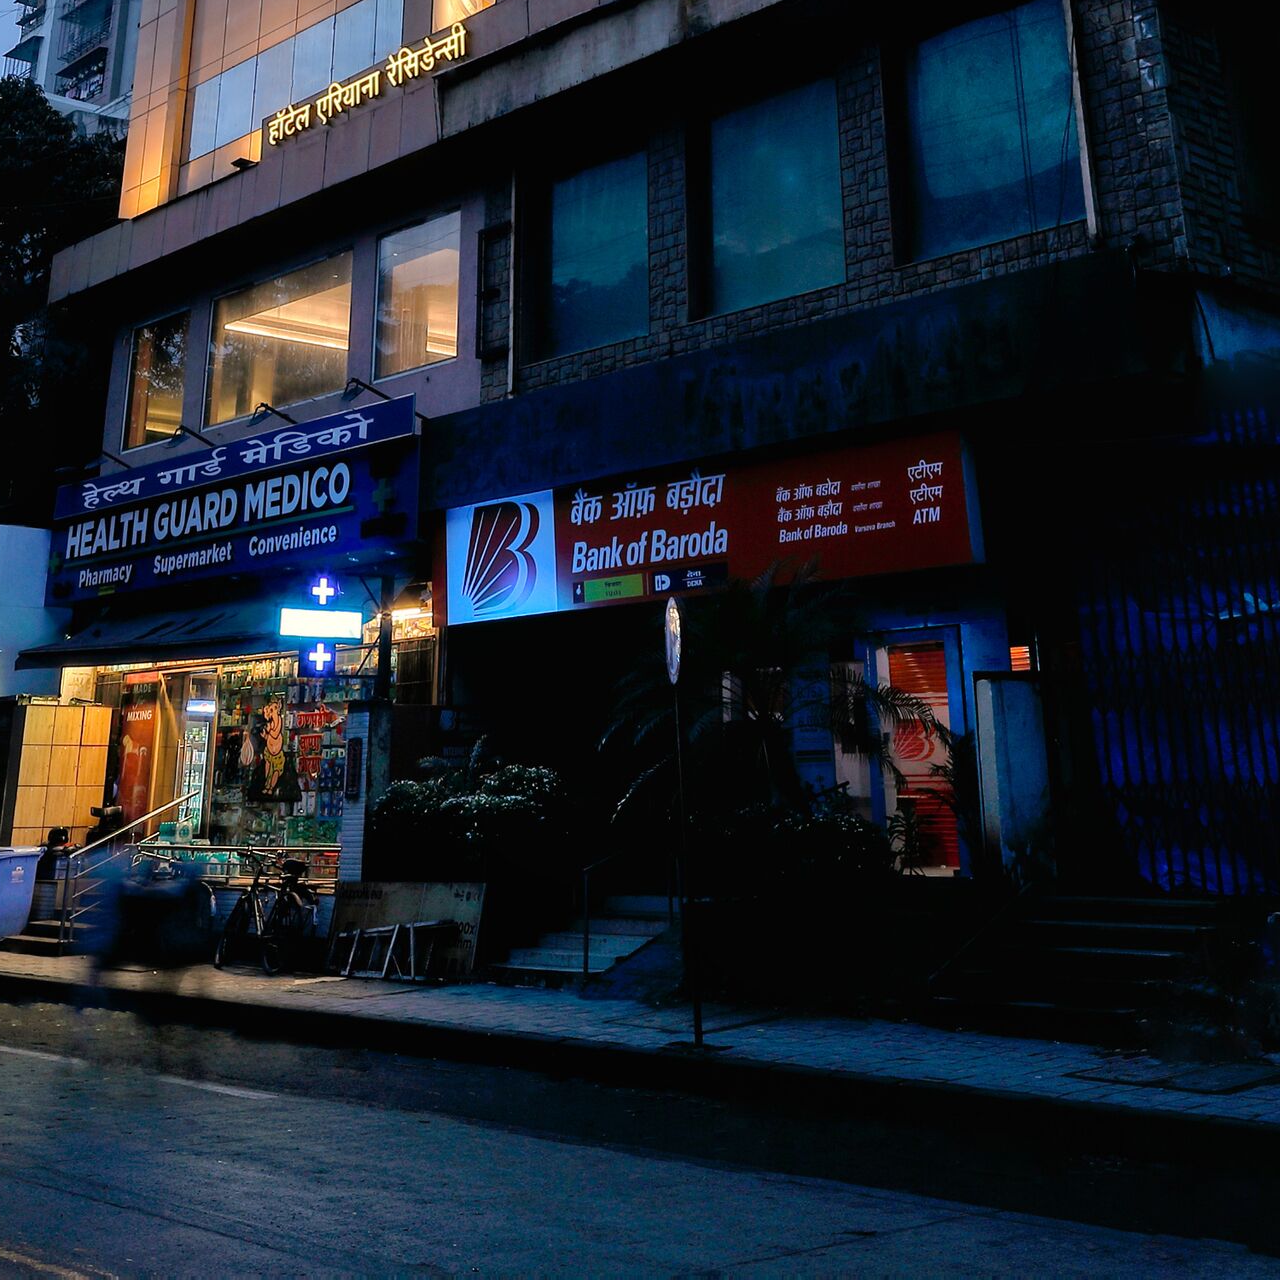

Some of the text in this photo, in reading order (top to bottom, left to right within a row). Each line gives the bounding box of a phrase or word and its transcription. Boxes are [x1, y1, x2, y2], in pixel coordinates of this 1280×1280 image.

[268, 22, 467, 145] हॉटेल एरियाना रेसिडेन्सी
[82, 413, 375, 508] हेल्थ गार्ड मेडिको
[907, 458, 943, 482] एटीएम
[66, 462, 350, 559] HEALTH GUARD MEDICO
[571, 468, 726, 526] बैंक ऑफ़ बड़ौदा
[909, 483, 943, 505] एटीएम
[913, 507, 941, 525] ATM
[78, 523, 337, 589] Pharmacy Supermarket Convenience
[572, 521, 728, 573] Bank of Baroda
[779, 527, 803, 543] Bank
[803, 525, 813, 540] of
[814, 521, 848, 538] Baroda
[876, 521, 896, 530] Branch
[127, 710, 152, 722] MIXING
